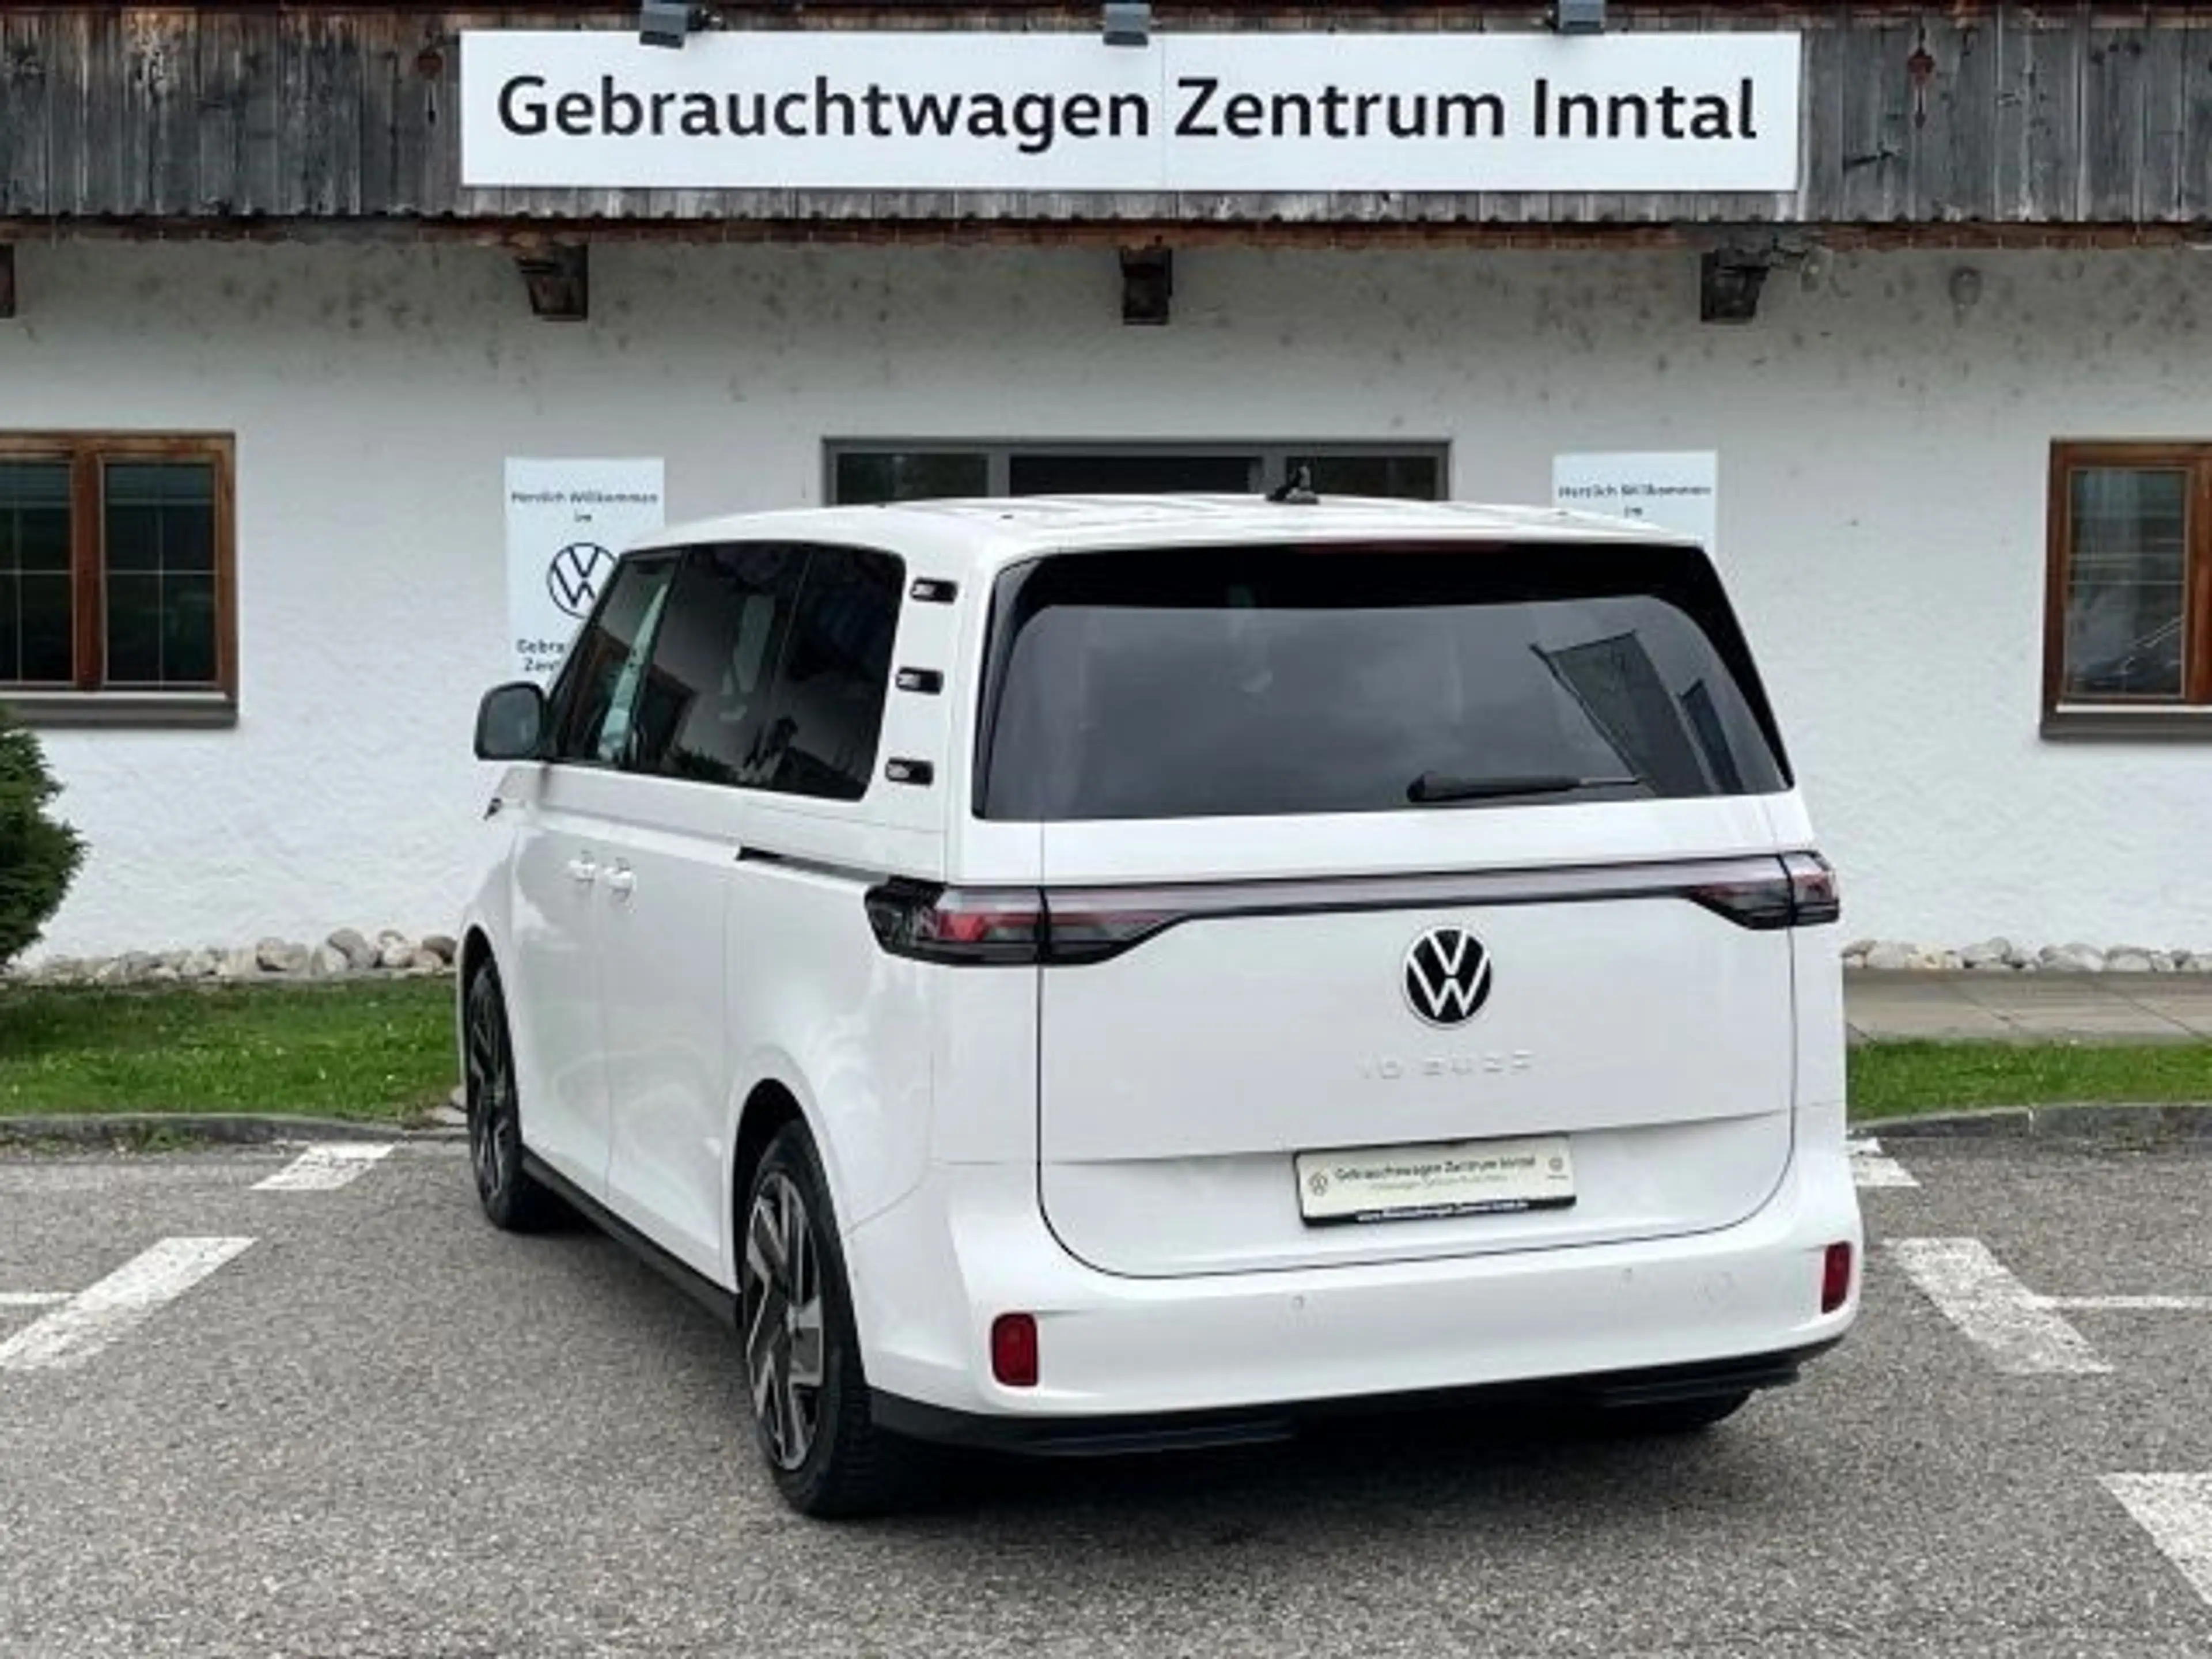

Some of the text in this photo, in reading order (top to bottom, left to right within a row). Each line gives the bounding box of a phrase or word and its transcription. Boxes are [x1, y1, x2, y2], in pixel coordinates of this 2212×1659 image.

[498, 75, 1758, 155] Gebrauchtwagen Zentrum Inntal
